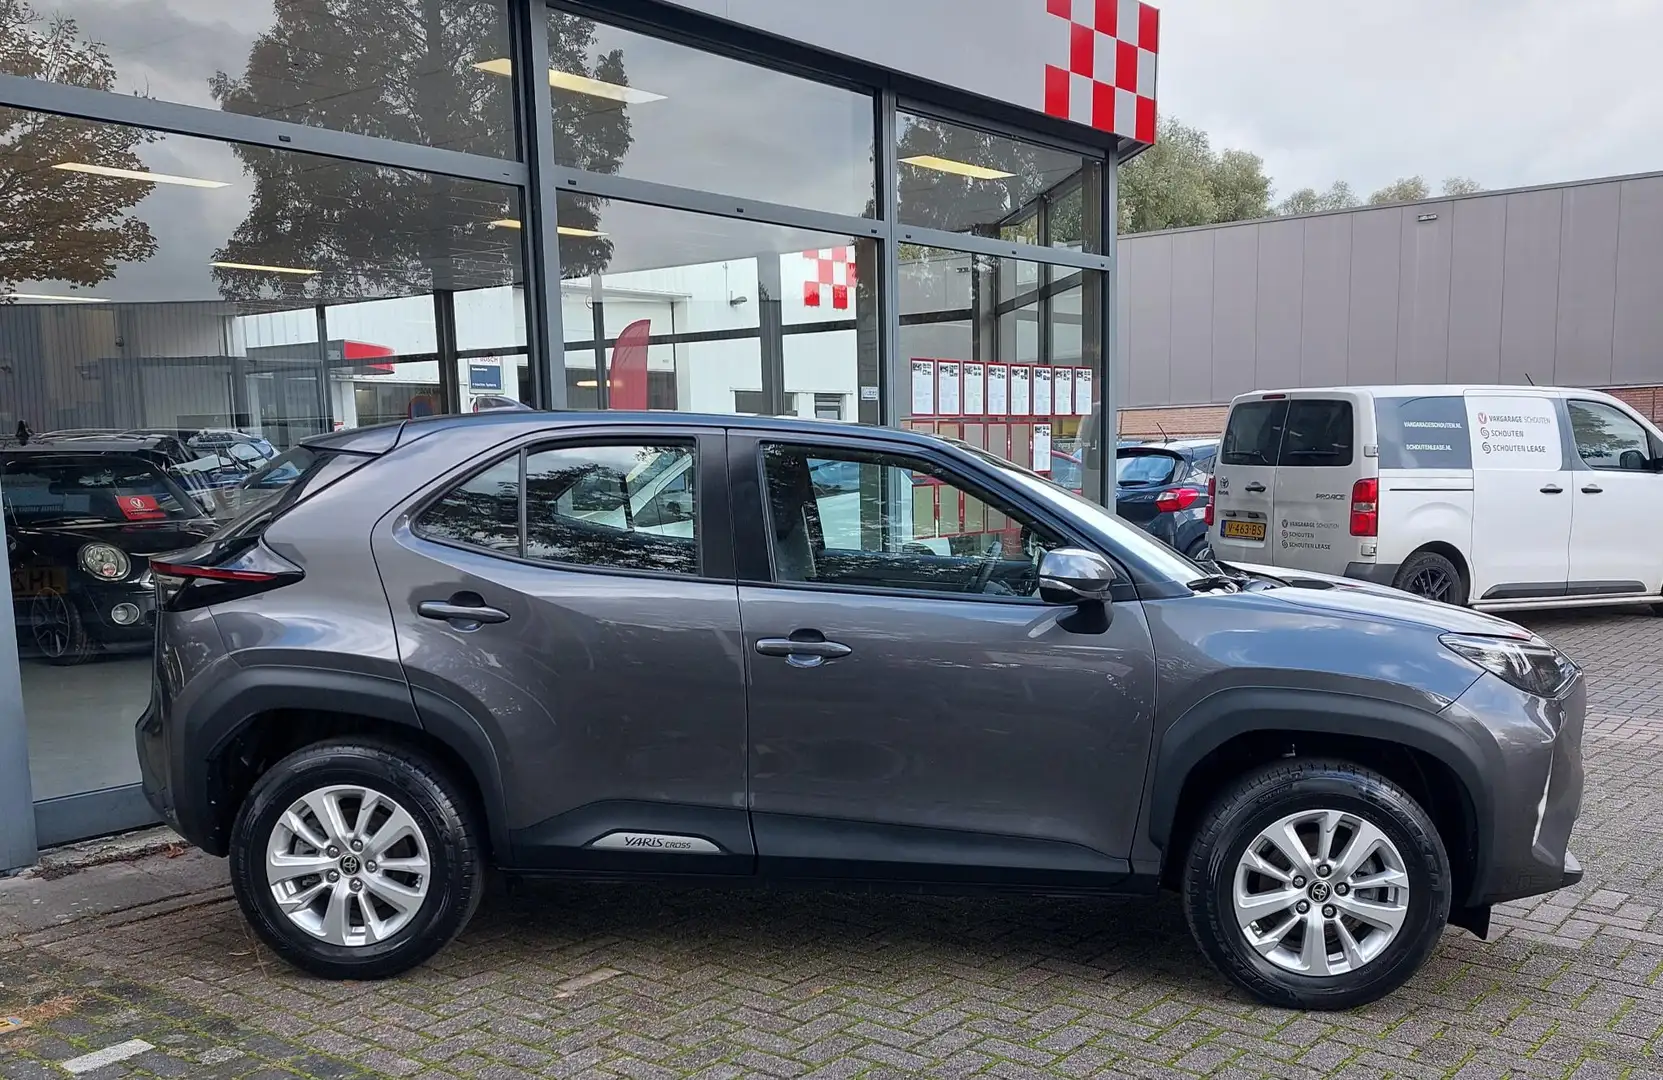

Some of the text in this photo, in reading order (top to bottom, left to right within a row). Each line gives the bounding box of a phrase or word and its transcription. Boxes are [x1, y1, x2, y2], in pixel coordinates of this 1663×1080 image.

[1489, 415, 1522, 423] VAKGARAGE
[1523, 416, 1551, 424] SCHOUTEN
[1491, 430, 1524, 438] SCHOUTEN
[1315, 493, 1346, 501] PROACE
[1228, 523, 1263, 536] V-463-BS
